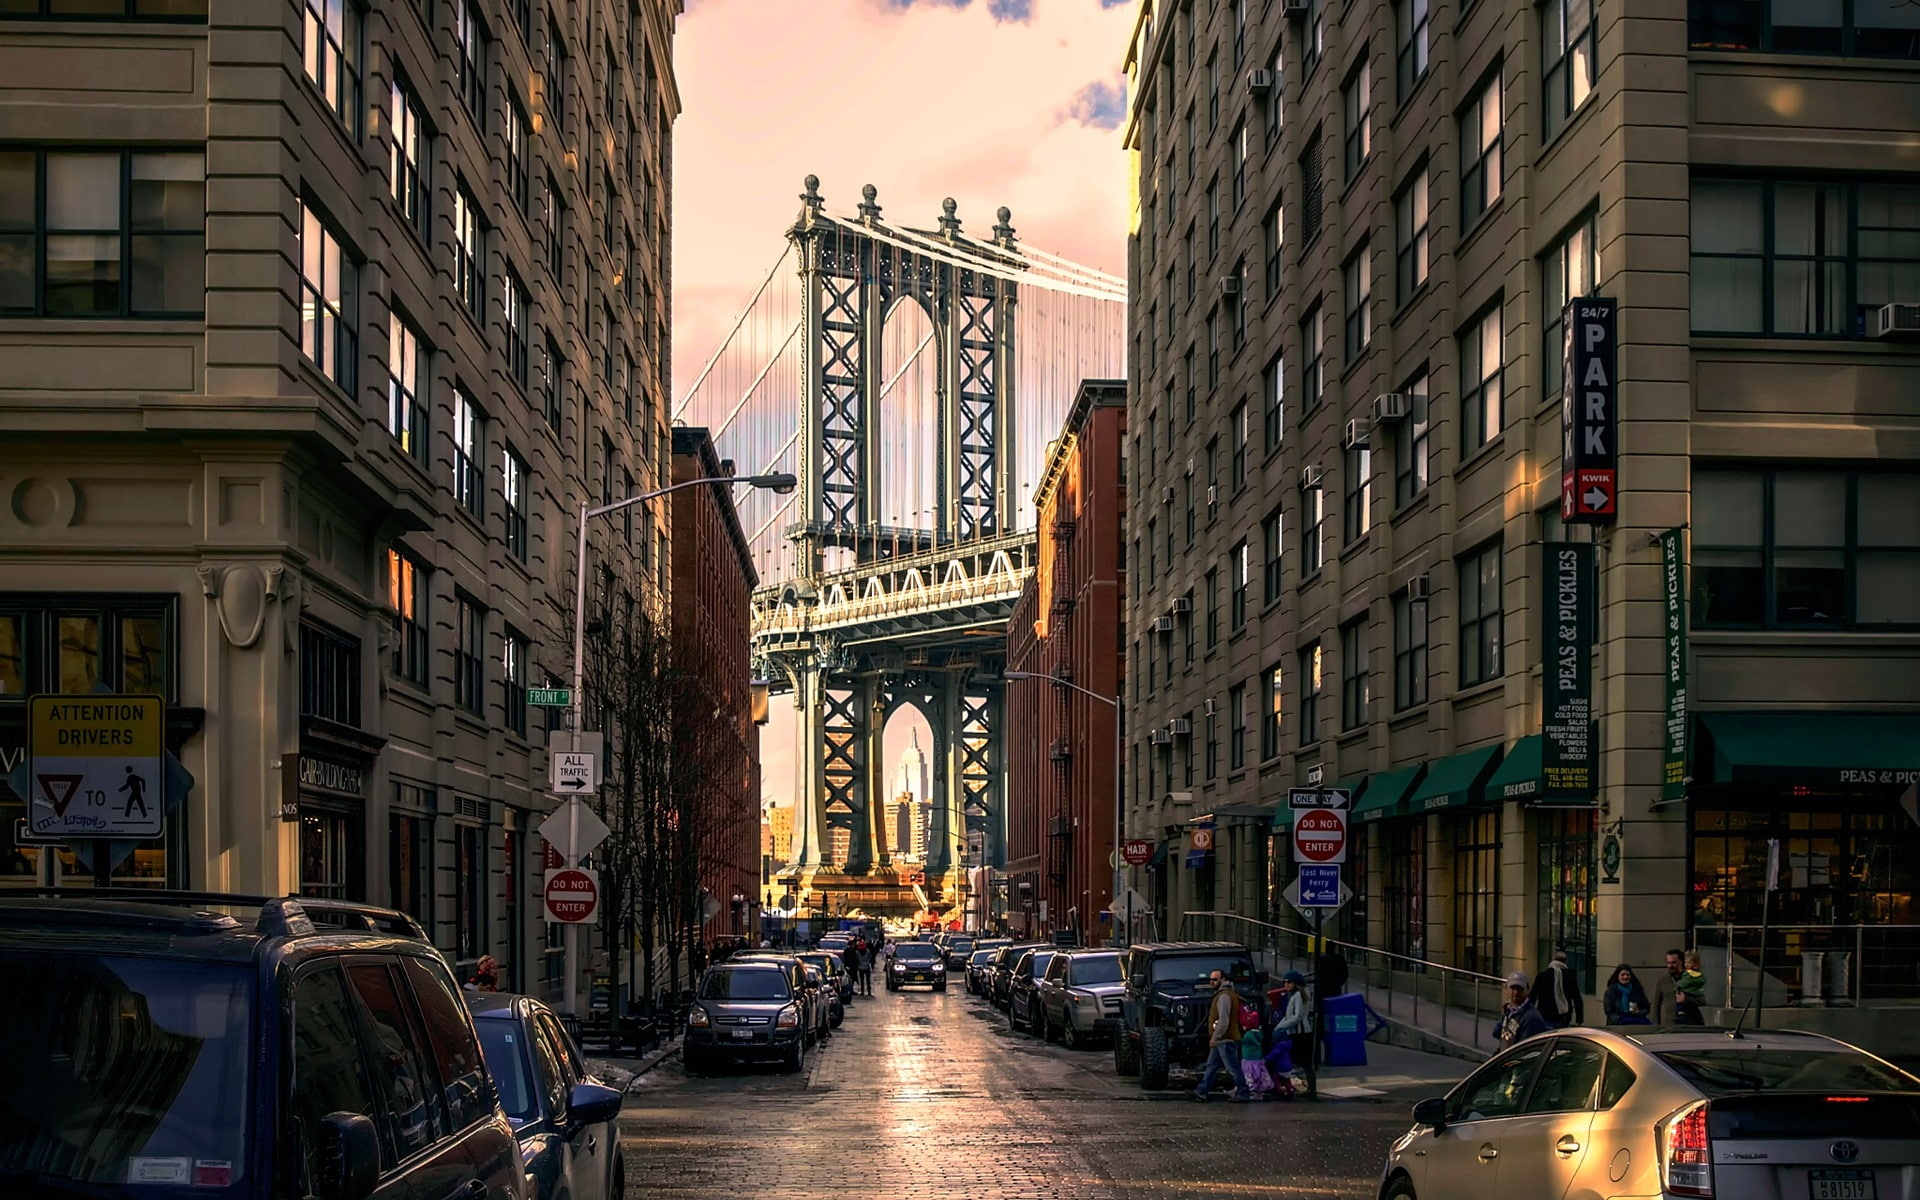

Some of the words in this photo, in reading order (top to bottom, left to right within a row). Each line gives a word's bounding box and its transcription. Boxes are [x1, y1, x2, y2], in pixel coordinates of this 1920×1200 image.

[1580, 307, 1609, 319] 24/7
[1583, 323, 1609, 455] PARK
[1581, 474, 1610, 482] KWIK
[1667, 536, 1678, 612] PICKLES
[1558, 549, 1577, 622] PICKLES
[1670, 614, 1679, 631] &
[1558, 625, 1578, 641] &
[1670, 635, 1680, 683] PEAS
[1558, 645, 1577, 691] PEAS
[529, 690, 559, 703] FRONT
[50, 705, 143, 721] ATTENTION
[1545, 725, 1566, 733] FRESH
[1567, 725, 1588, 733] FRUITS
[58, 729, 134, 745] DRIVERS
[564, 755, 584, 766] ALL
[560, 767, 588, 777] TRAFFIC
[1839, 769, 1877, 783] PEAS
[1879, 770, 1893, 784] &
[1895, 771, 1920, 784] PIC
[85, 790, 106, 806] TO
[1295, 795, 1313, 804] ONE
[1302, 819, 1315, 829] DO
[1320, 819, 1339, 829] NOT
[1126, 844, 1147, 855] HAIR
[1305, 842, 1334, 852] ENTER
[1301, 868, 1317, 877] East
[1319, 868, 1338, 877] River
[552, 880, 566, 889] DO
[571, 880, 589, 889] NOT
[1309, 880, 1329, 888] Ferry
[556, 903, 586, 913] ENTER
[1830, 1181, 1865, 1198] 81519
